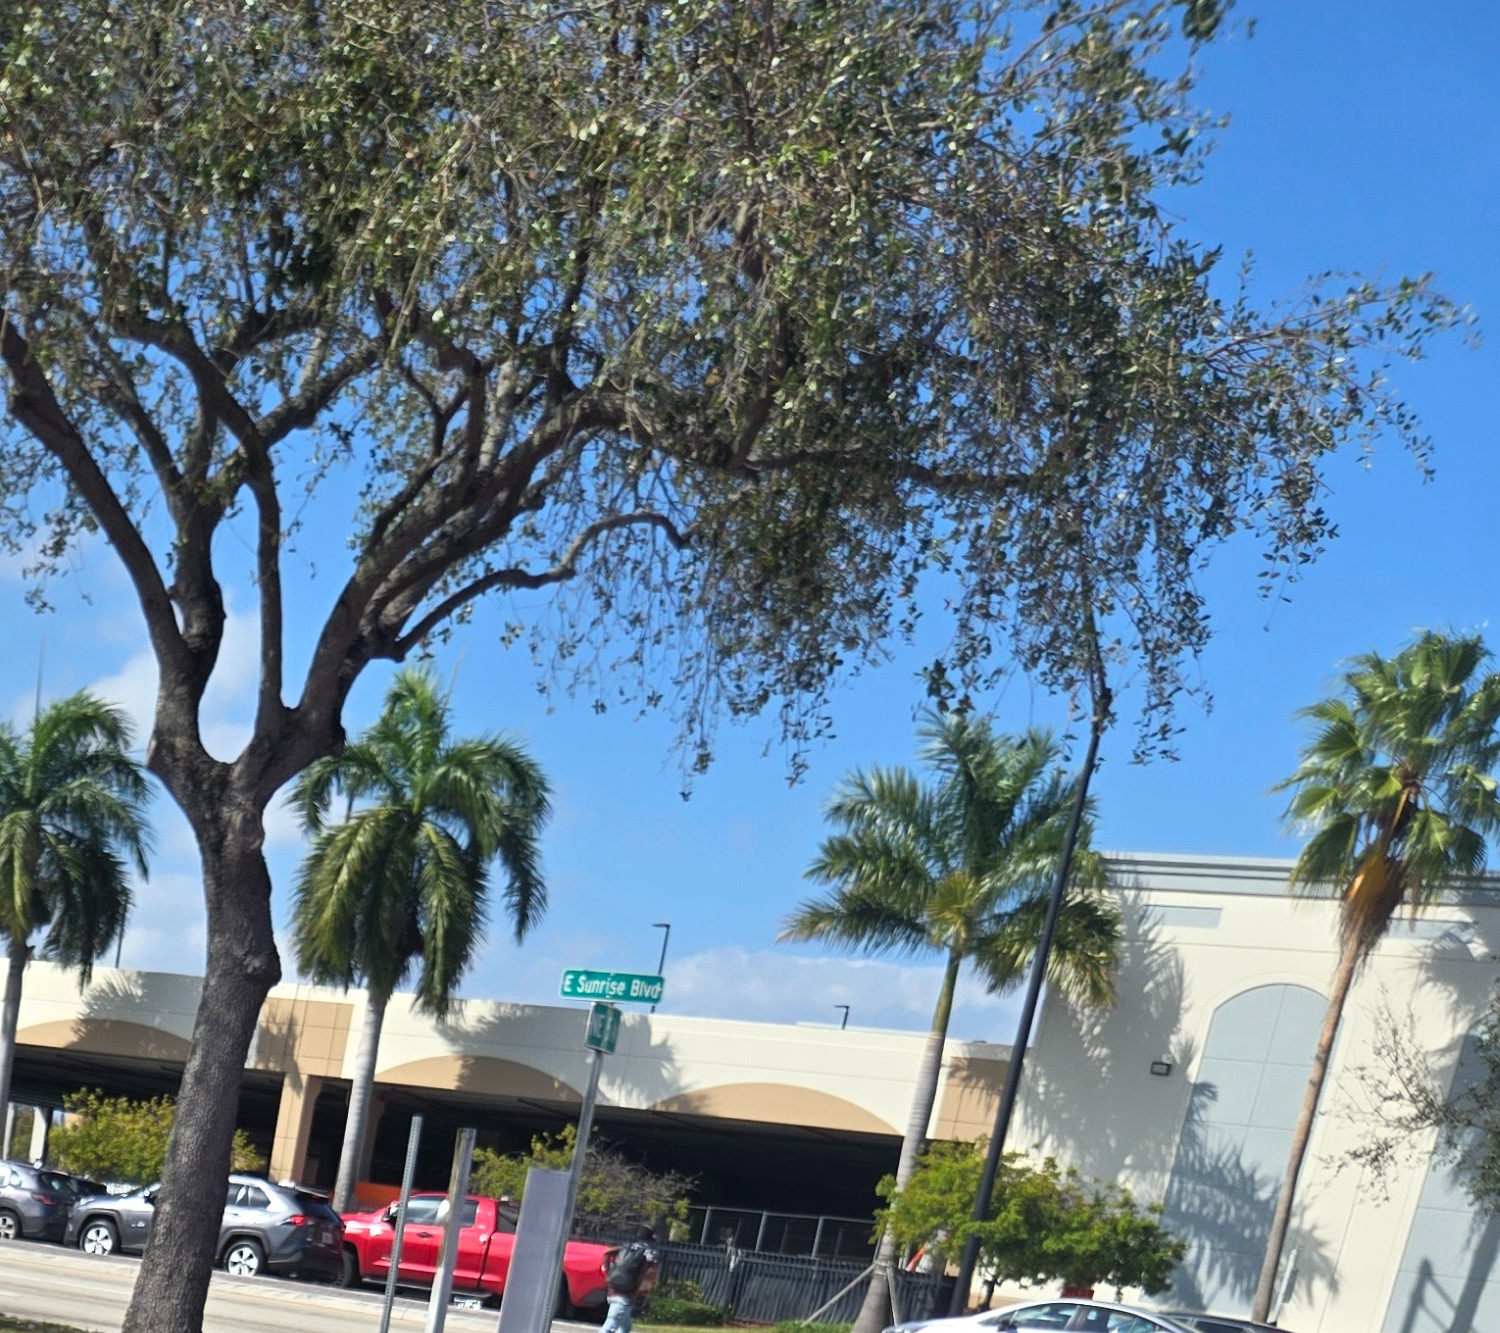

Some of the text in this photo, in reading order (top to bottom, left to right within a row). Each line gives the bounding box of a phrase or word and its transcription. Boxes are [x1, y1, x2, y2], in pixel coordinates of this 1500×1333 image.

[563, 974, 662, 999] E Sunrise Blvd
